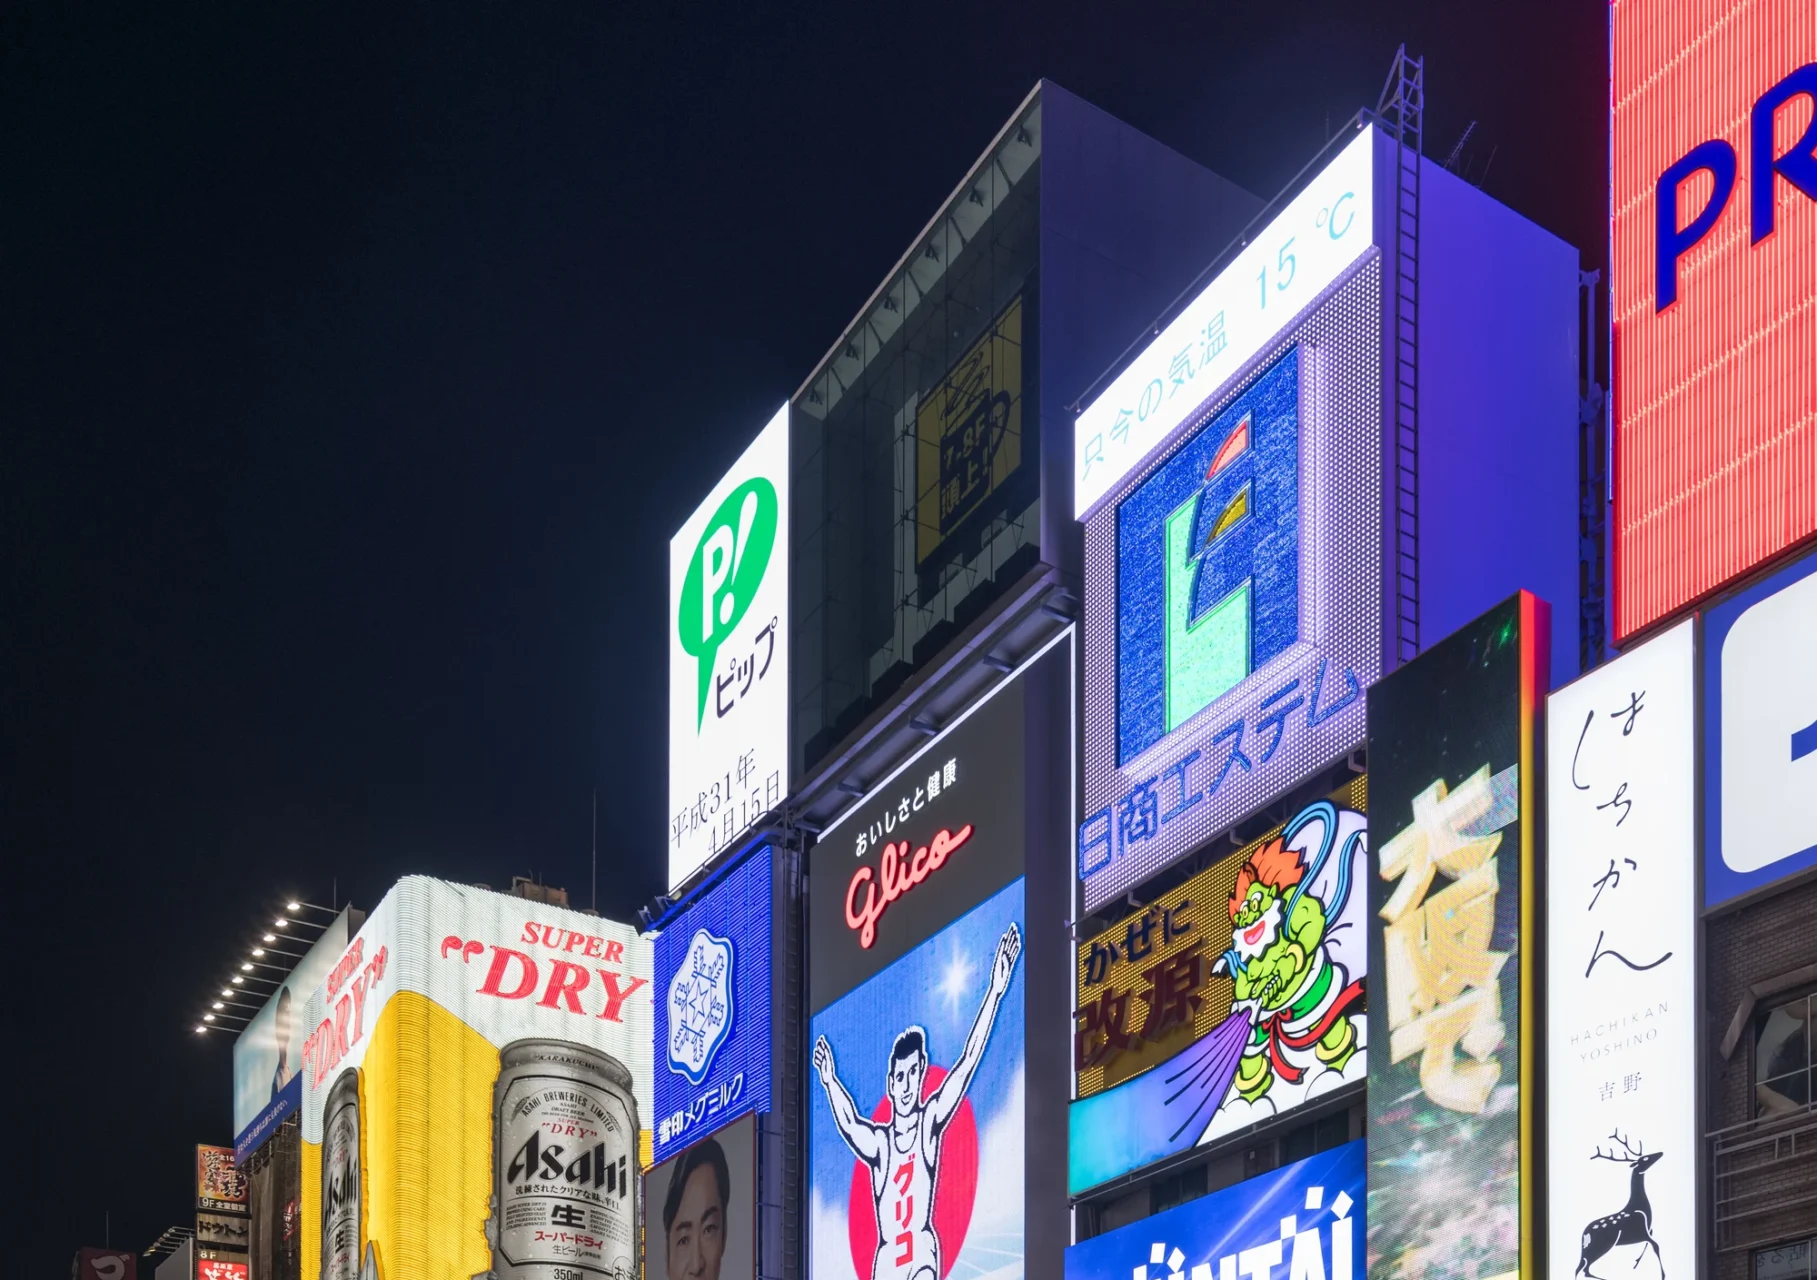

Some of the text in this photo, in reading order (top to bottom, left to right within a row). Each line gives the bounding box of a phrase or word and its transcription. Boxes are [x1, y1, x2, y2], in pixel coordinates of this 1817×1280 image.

[1082, 309, 1228, 482] 只今の気温
[1255, 236, 1296, 310] 15
[716, 616, 778, 718] ピップ
[670, 748, 756, 849] 平成31年
[1079, 657, 1360, 881] 日商エステム
[707, 770, 780, 855] 4月15日
[855, 757, 956, 857] おいしさと健康
[845, 824, 971, 949] Glico
[326, 937, 364, 1004] SUPER
[521, 921, 624, 964] SUPER
[1083, 901, 1192, 986] かぜに
[1073, 945, 1205, 1076] 改源
[1570, 1001, 1669, 1046] HACHIKAN
[1579, 1027, 1658, 1063] YOSHINO
[521, 1091, 614, 1132] ASAHI BREWERIES LIMITED
[557, 1118, 580, 1126] SUPER
[658, 1072, 744, 1145] 雪印メグミルク
[1598, 1072, 1643, 1102] 吉野
[507, 1130, 626, 1199] Asahi
[202, 1197, 215, 1208] 9F
[551, 1204, 586, 1229] 生
[893, 1153, 915, 1268] グリコ
[534, 1231, 603, 1250] スーパードライ
